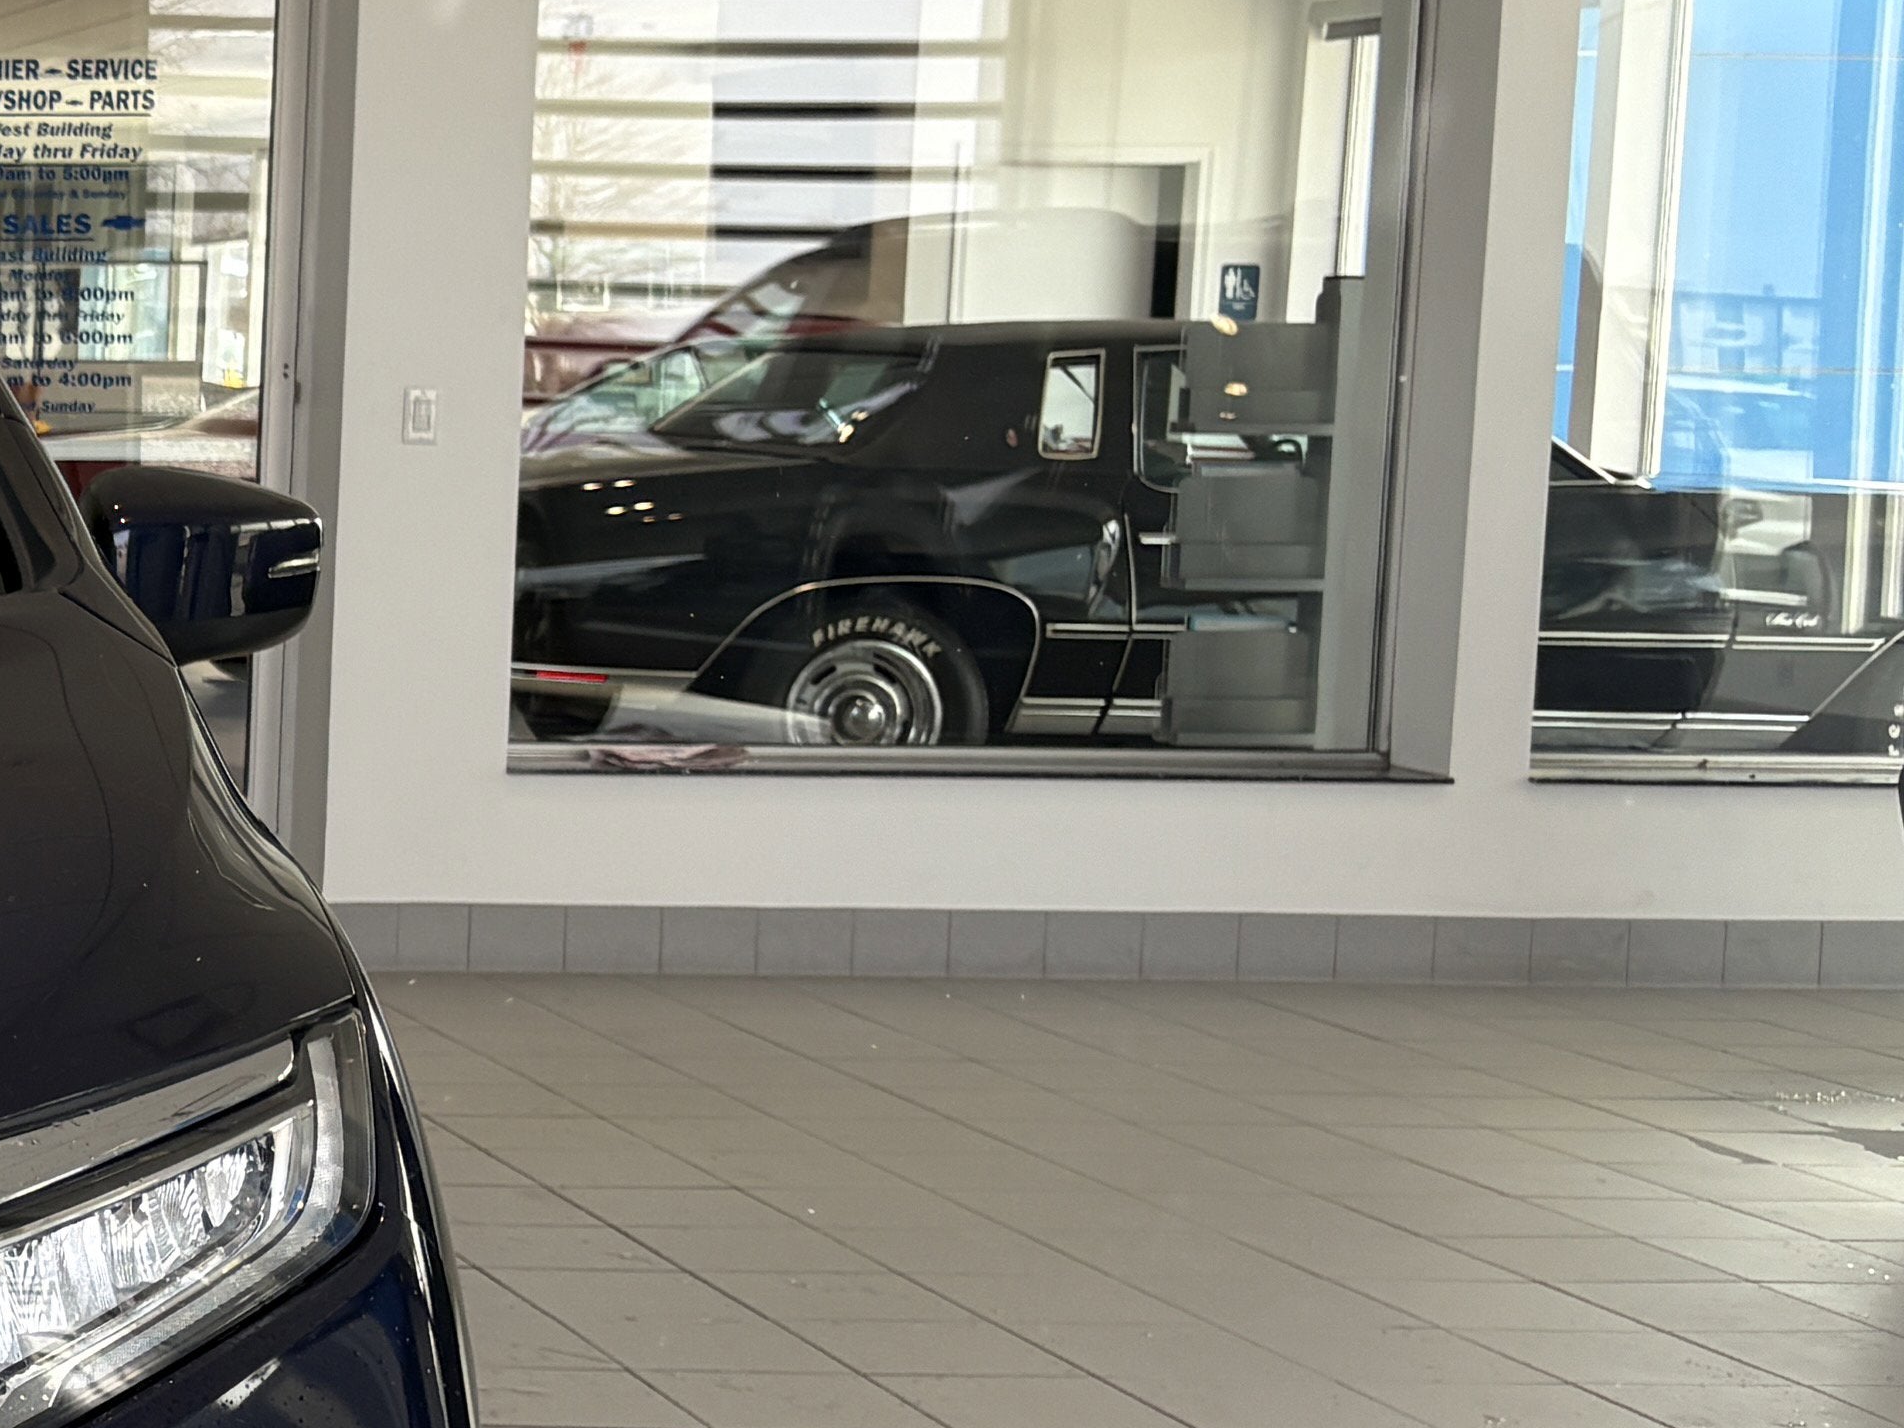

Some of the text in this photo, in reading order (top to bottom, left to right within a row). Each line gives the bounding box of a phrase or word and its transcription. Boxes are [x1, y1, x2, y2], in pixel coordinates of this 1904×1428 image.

[66, 58, 158, 81] SERVICE
[89, 89, 155, 111] PARTS
[36, 122, 113, 140] Building
[33, 143, 73, 160] thru
[79, 143, 143, 162] Friday
[38, 166, 56, 182] to
[2, 213, 93, 235] SALES
[31, 247, 109, 264] Building
[31, 372, 51, 387] to
[58, 372, 132, 389] 4:00pm
[41, 399, 96, 413] Sunday
[812, 616, 942, 658] FIREHAWK
